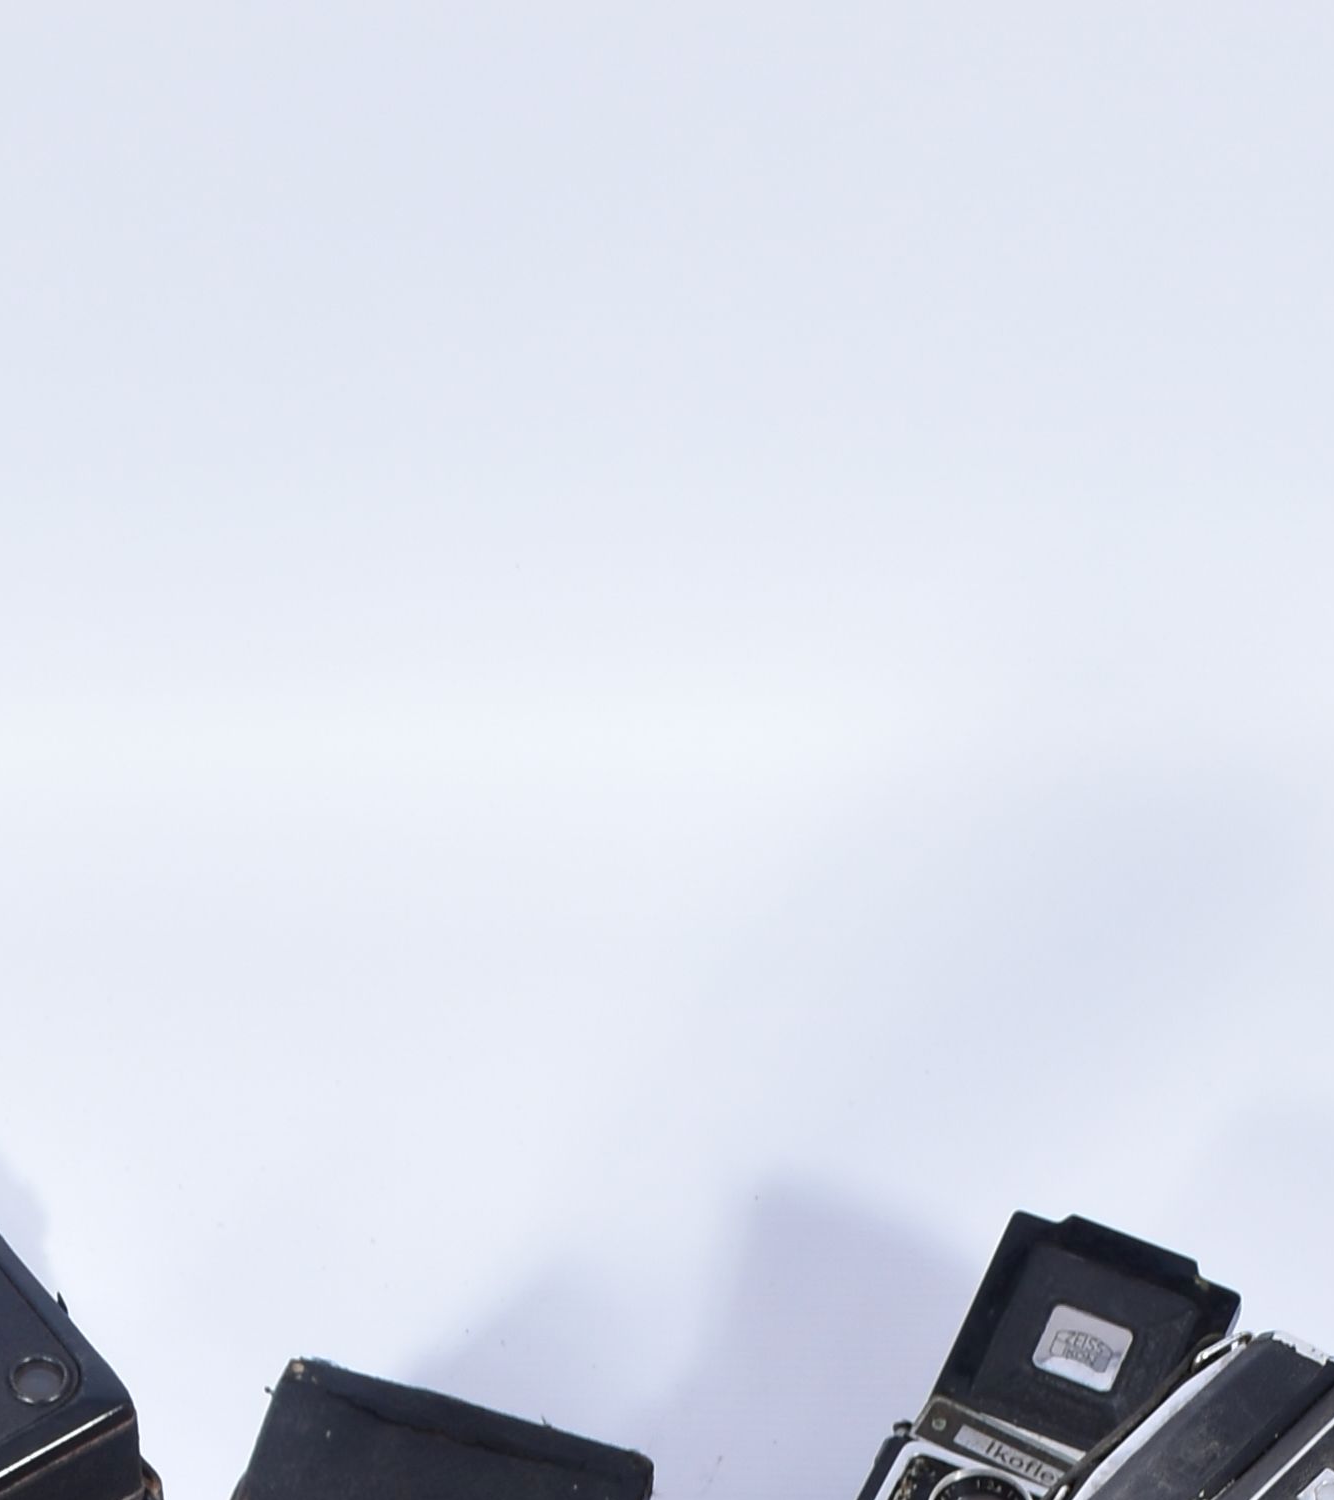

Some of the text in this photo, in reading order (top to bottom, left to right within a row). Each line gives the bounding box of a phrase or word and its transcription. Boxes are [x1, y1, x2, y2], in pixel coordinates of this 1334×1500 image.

[1066, 1331, 1104, 1354] ZEISS
[1062, 1349, 1098, 1368] IKON
[985, 1440, 1056, 1482] Ikofle
